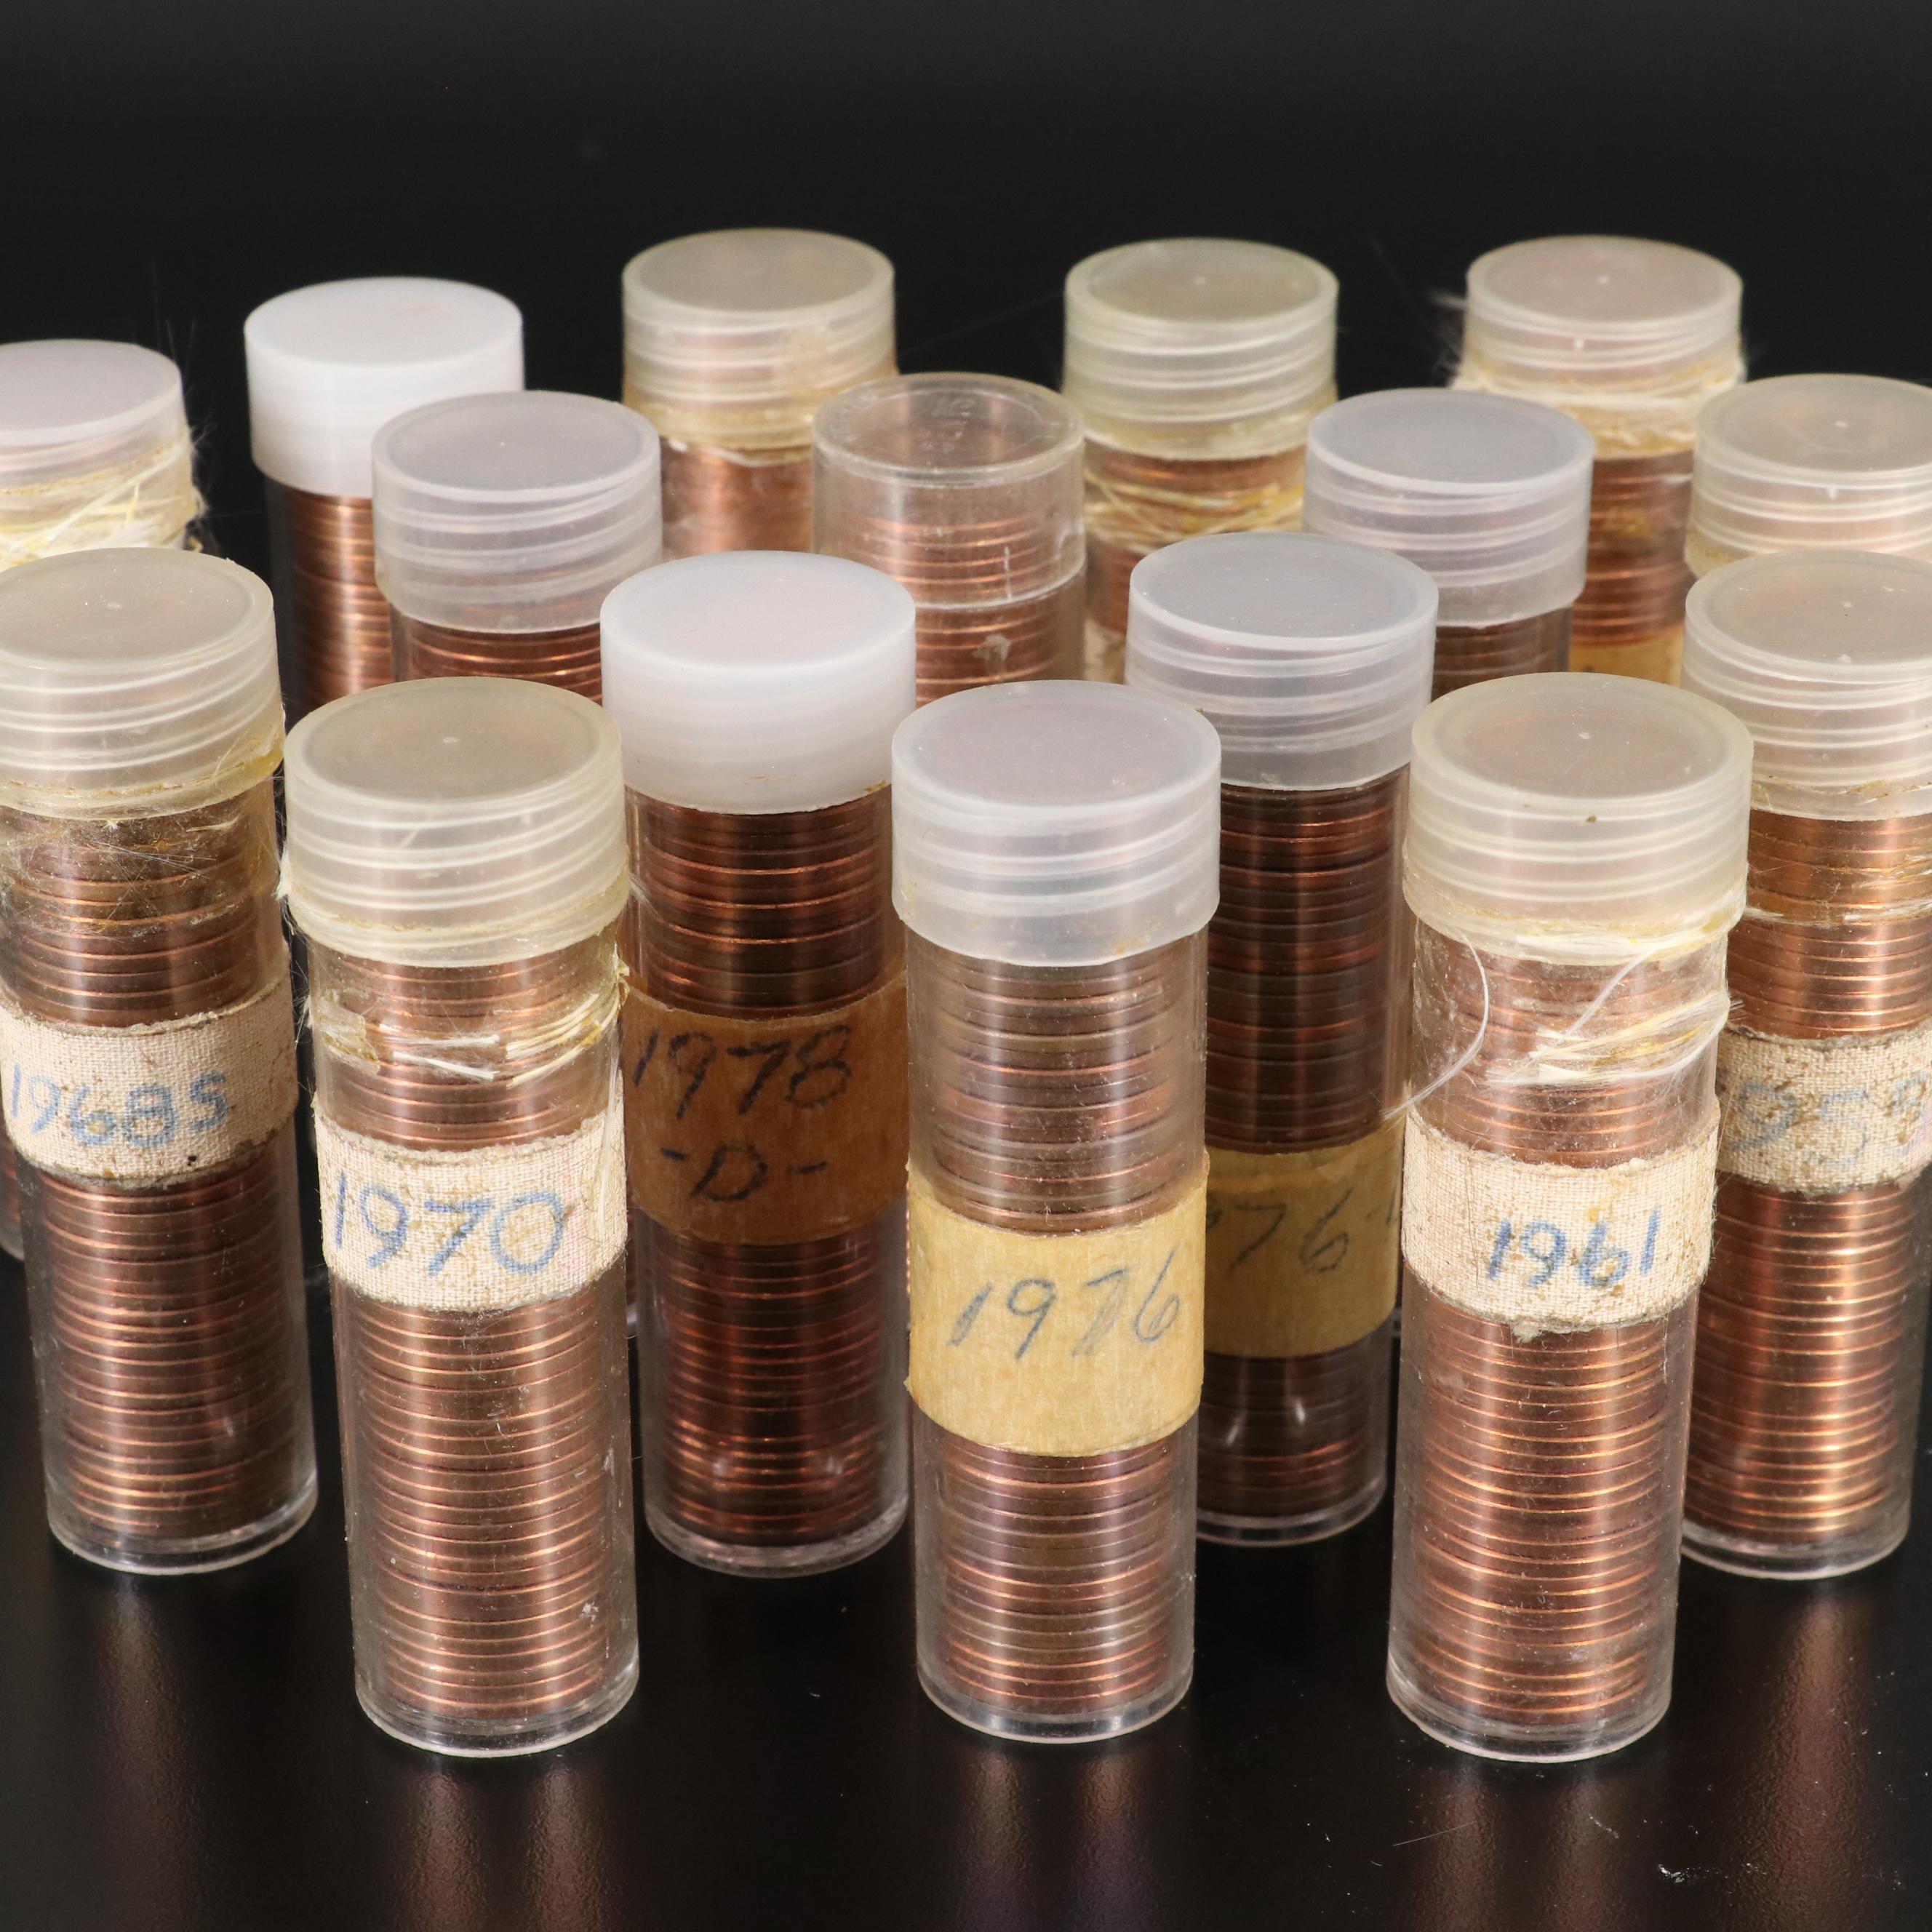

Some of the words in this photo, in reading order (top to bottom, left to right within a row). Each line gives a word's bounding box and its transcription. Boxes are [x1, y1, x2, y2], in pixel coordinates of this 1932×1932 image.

[633, 1024, 852, 1119] 1978
[335, 1172, 564, 1277] 1970
[1488, 1207, 1662, 1288] 1961
[949, 1242, 1181, 1360] 1976
